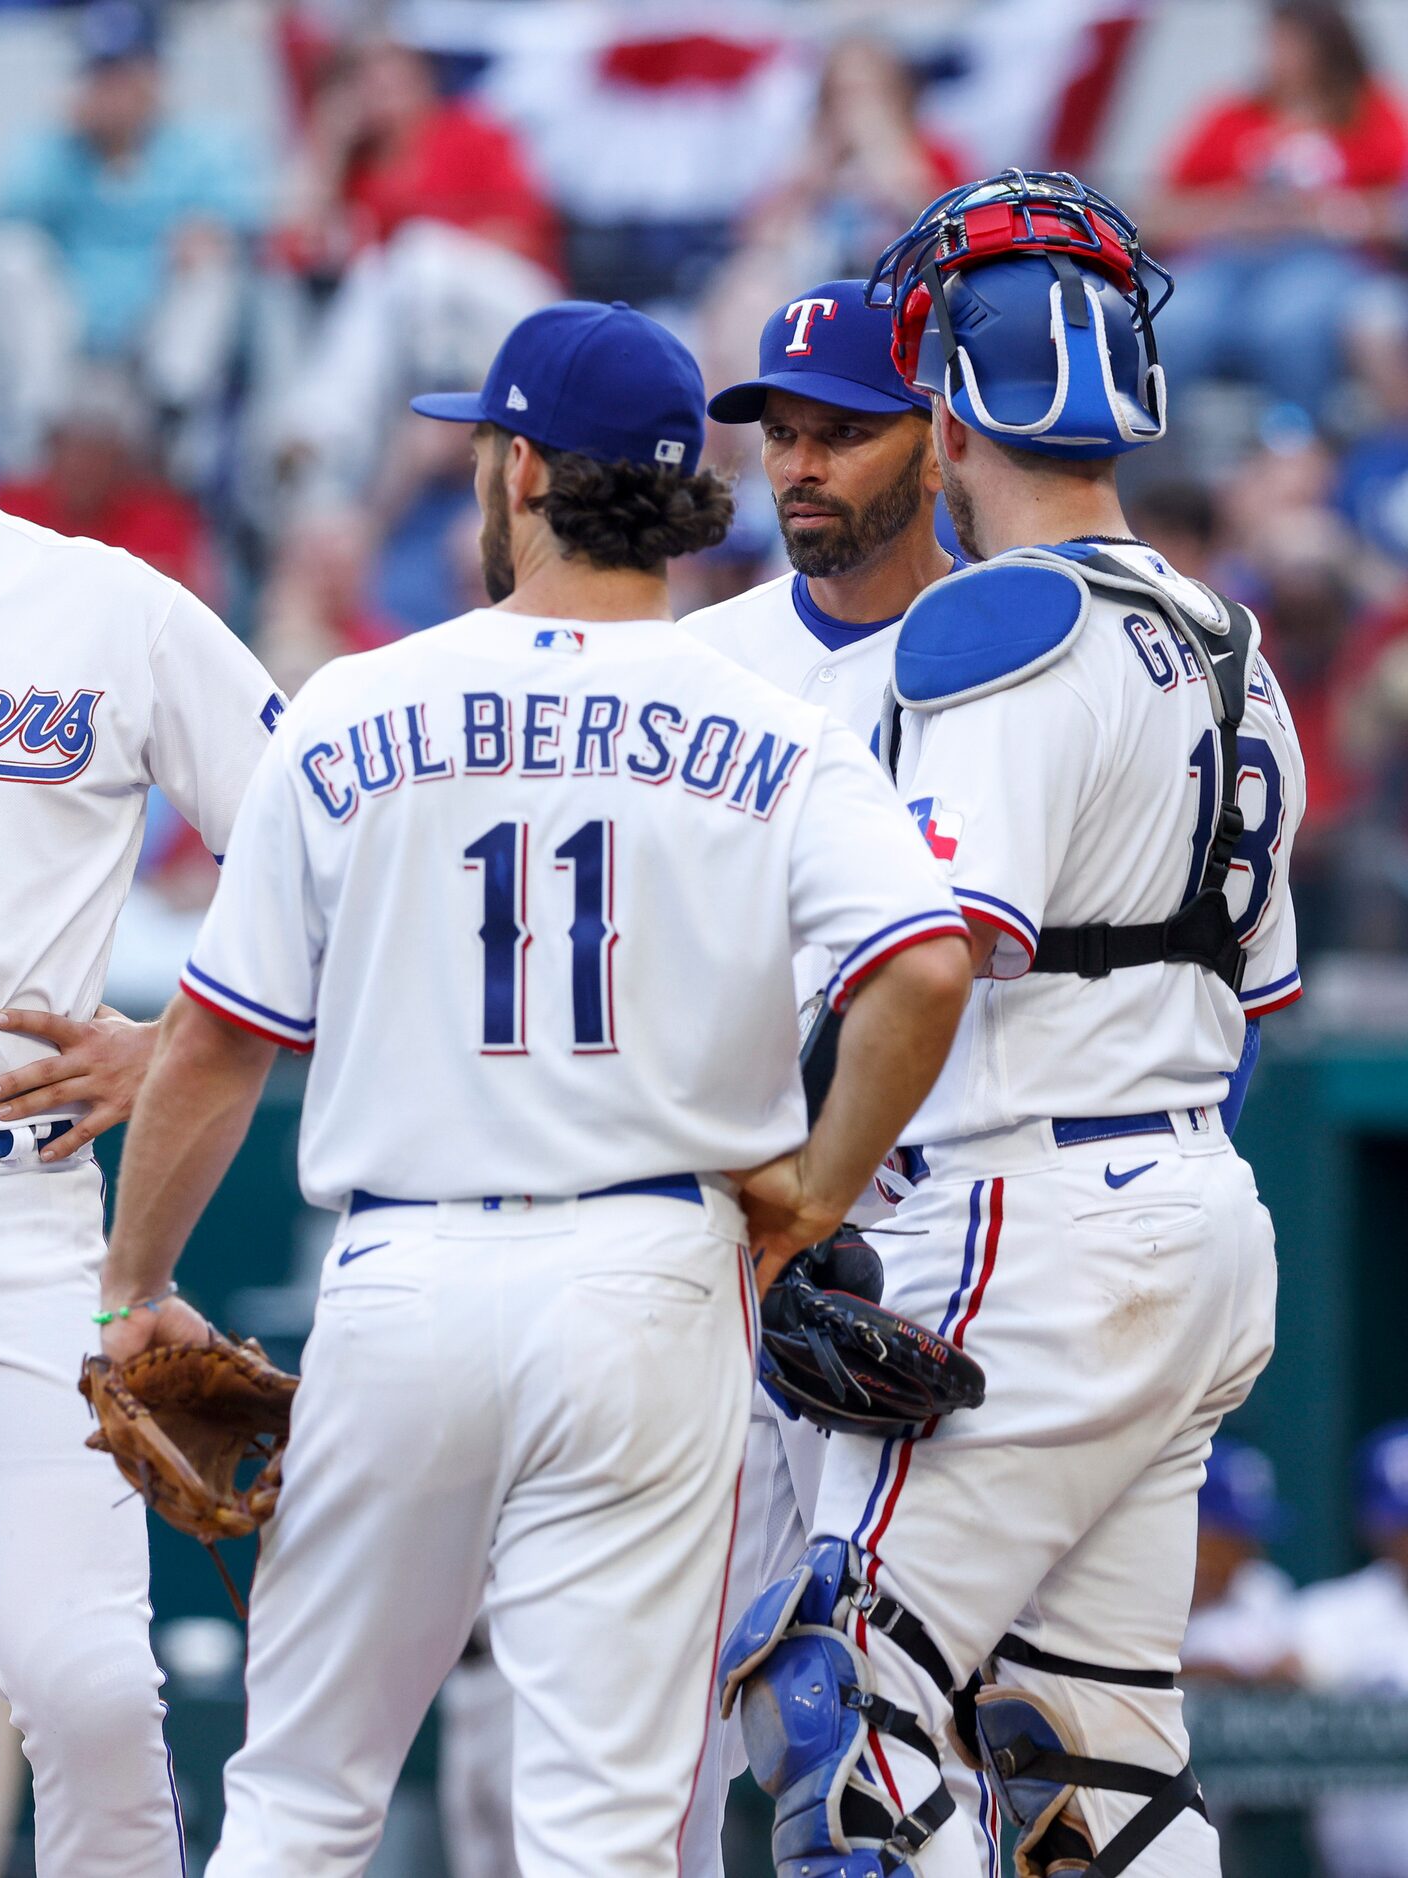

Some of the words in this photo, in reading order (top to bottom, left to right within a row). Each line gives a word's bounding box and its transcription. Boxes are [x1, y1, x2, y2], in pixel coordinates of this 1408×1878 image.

[784, 298, 838, 357] T
[301, 690, 809, 825] CULBERSON
[1178, 728, 1285, 945] 18
[463, 818, 620, 1056] 11
